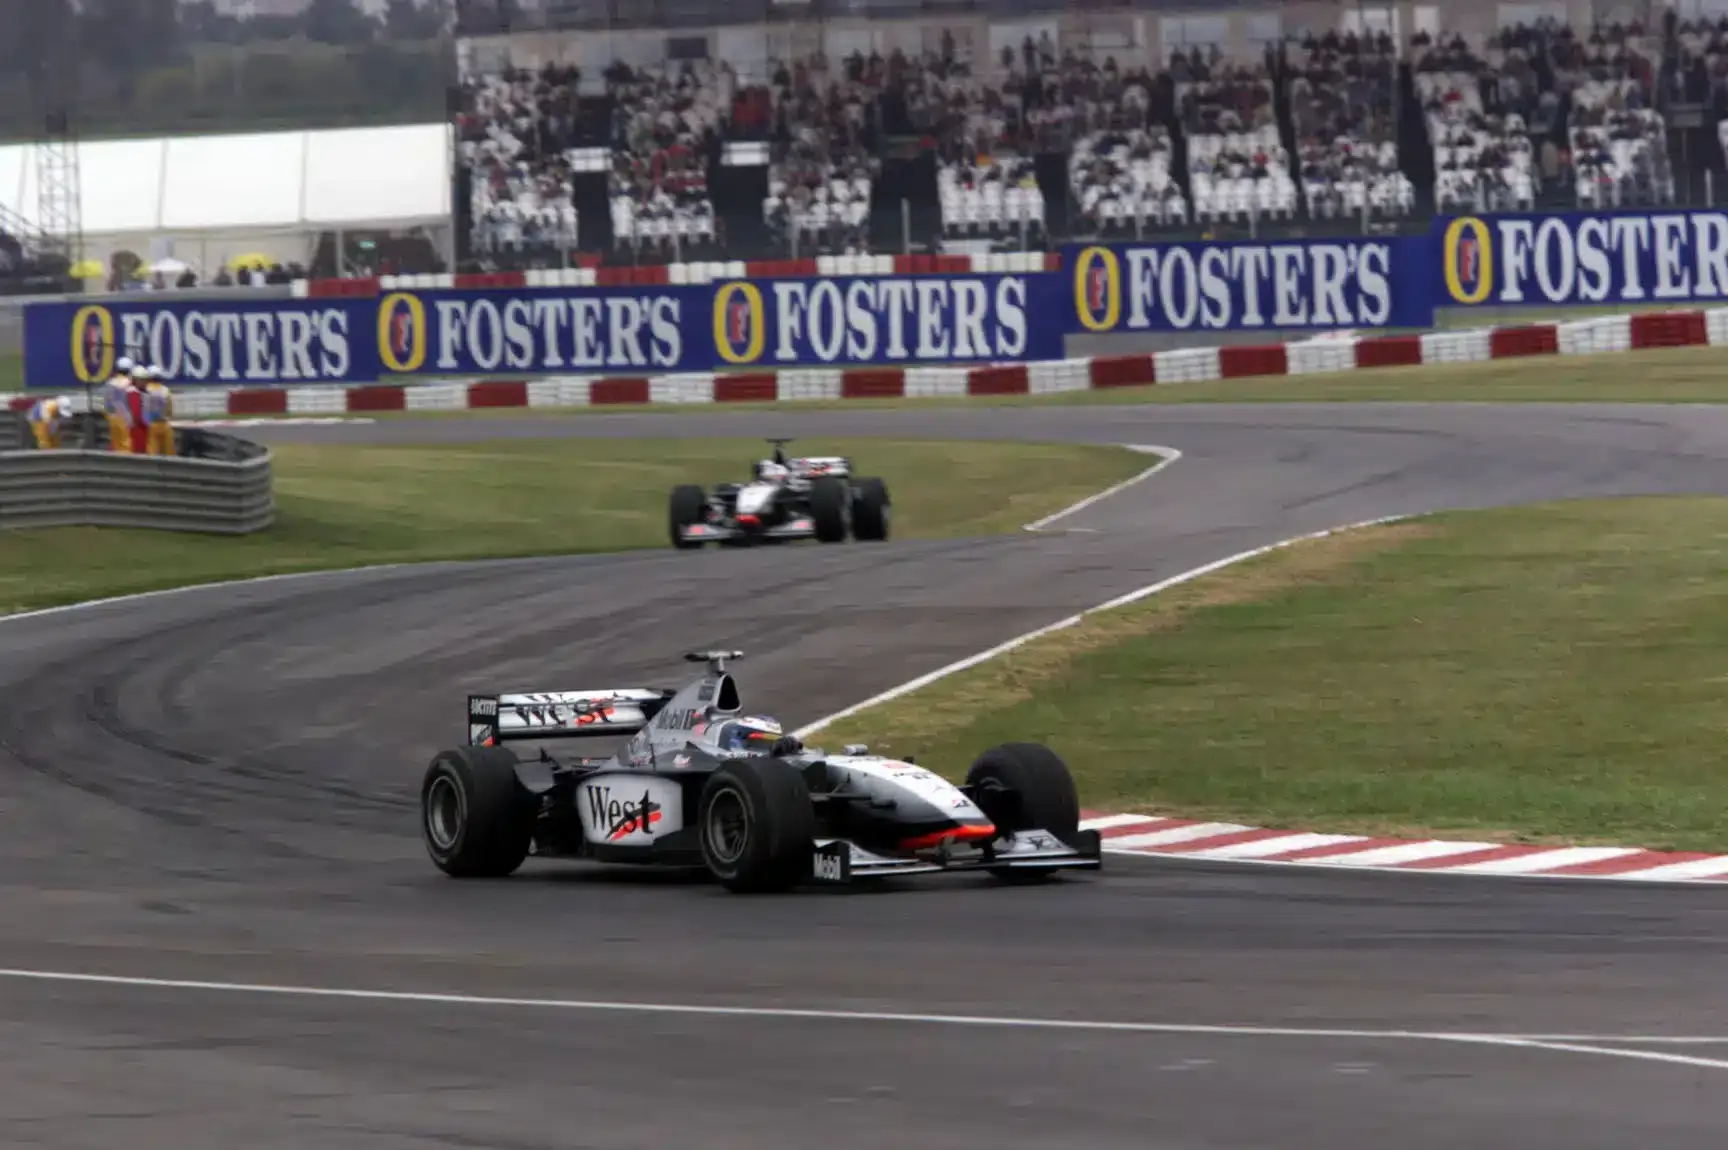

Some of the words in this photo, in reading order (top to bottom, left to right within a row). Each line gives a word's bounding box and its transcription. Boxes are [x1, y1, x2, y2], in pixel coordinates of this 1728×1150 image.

[1125, 244, 1391, 328] FOSTER'S
[1497, 213, 1728, 302] FOSTER
[121, 308, 349, 379] FOSTER'S
[434, 296, 682, 369] FOSTER'S
[587, 785, 653, 834] West
